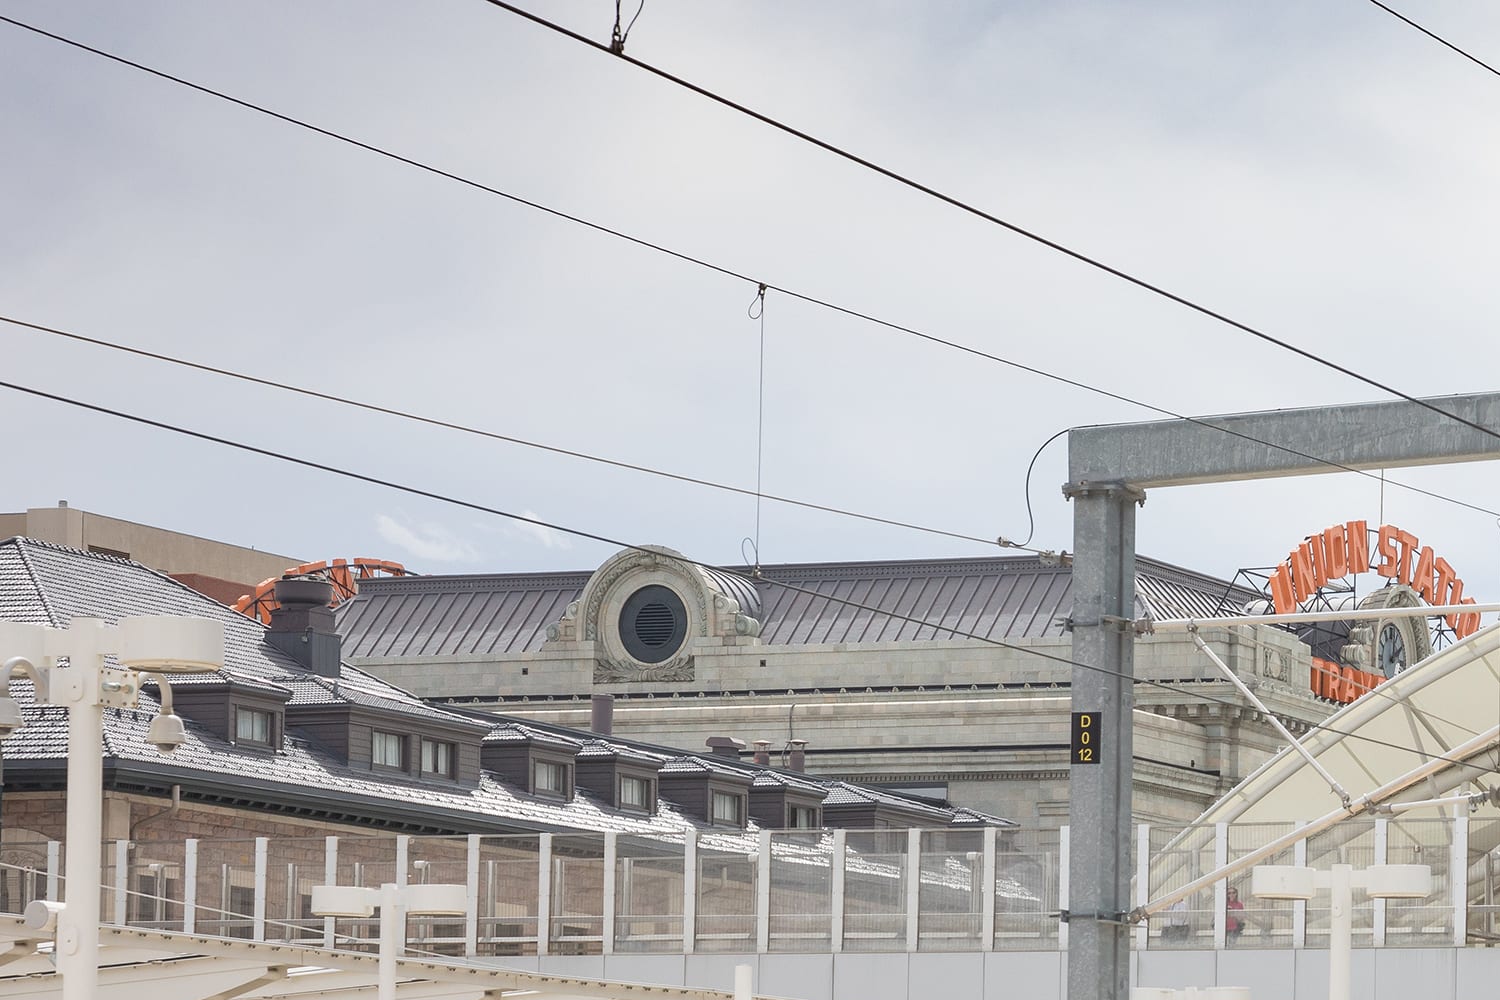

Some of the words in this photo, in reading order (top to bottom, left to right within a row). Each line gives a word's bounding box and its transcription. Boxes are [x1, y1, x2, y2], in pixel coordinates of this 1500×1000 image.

[1269, 520, 1369, 614] UNION
[1377, 524, 1482, 641] STATIO
[1311, 656, 1389, 704] TRAV
[1081, 715, 1091, 728] D
[1078, 748, 1093, 761] 12
